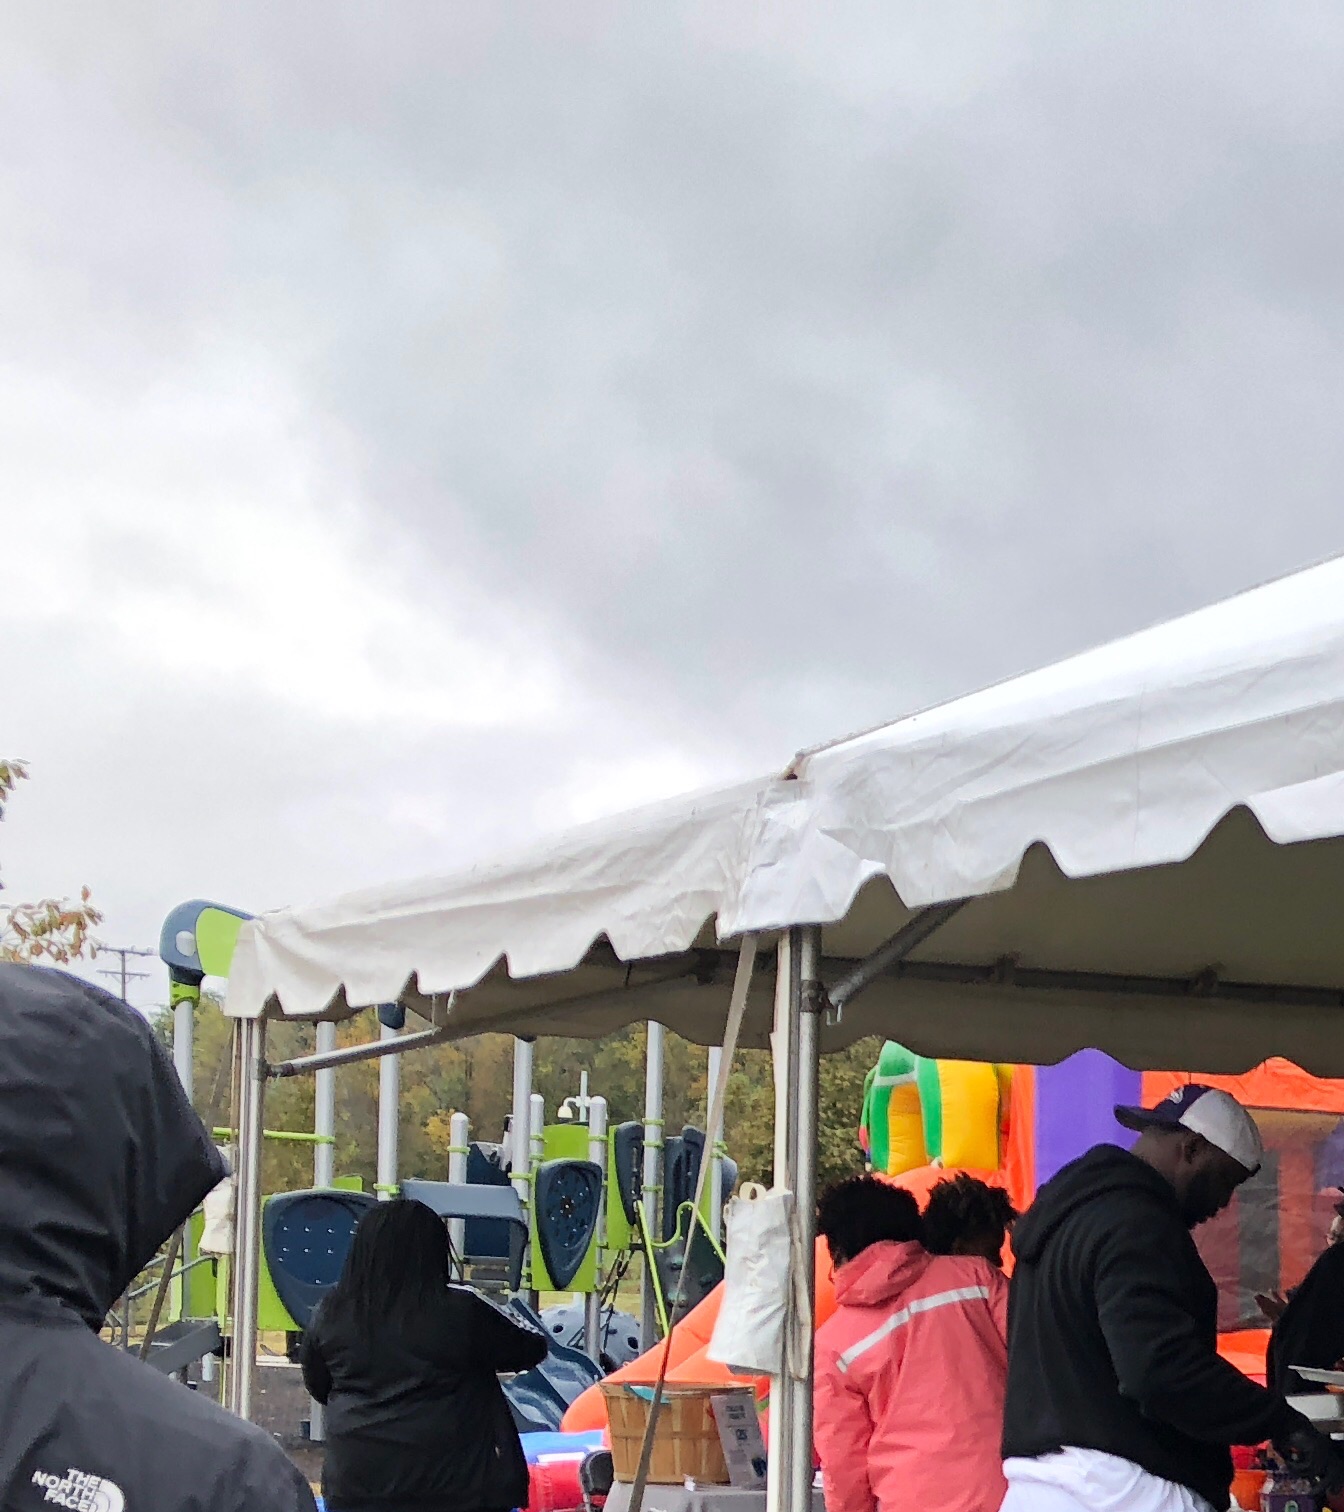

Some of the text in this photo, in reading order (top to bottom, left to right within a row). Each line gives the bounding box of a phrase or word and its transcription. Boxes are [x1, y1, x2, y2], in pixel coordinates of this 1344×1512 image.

[32, 1470, 97, 1501] NORTH
[67, 1468, 101, 1488] THE
[44, 1489, 91, 1512] FACE
